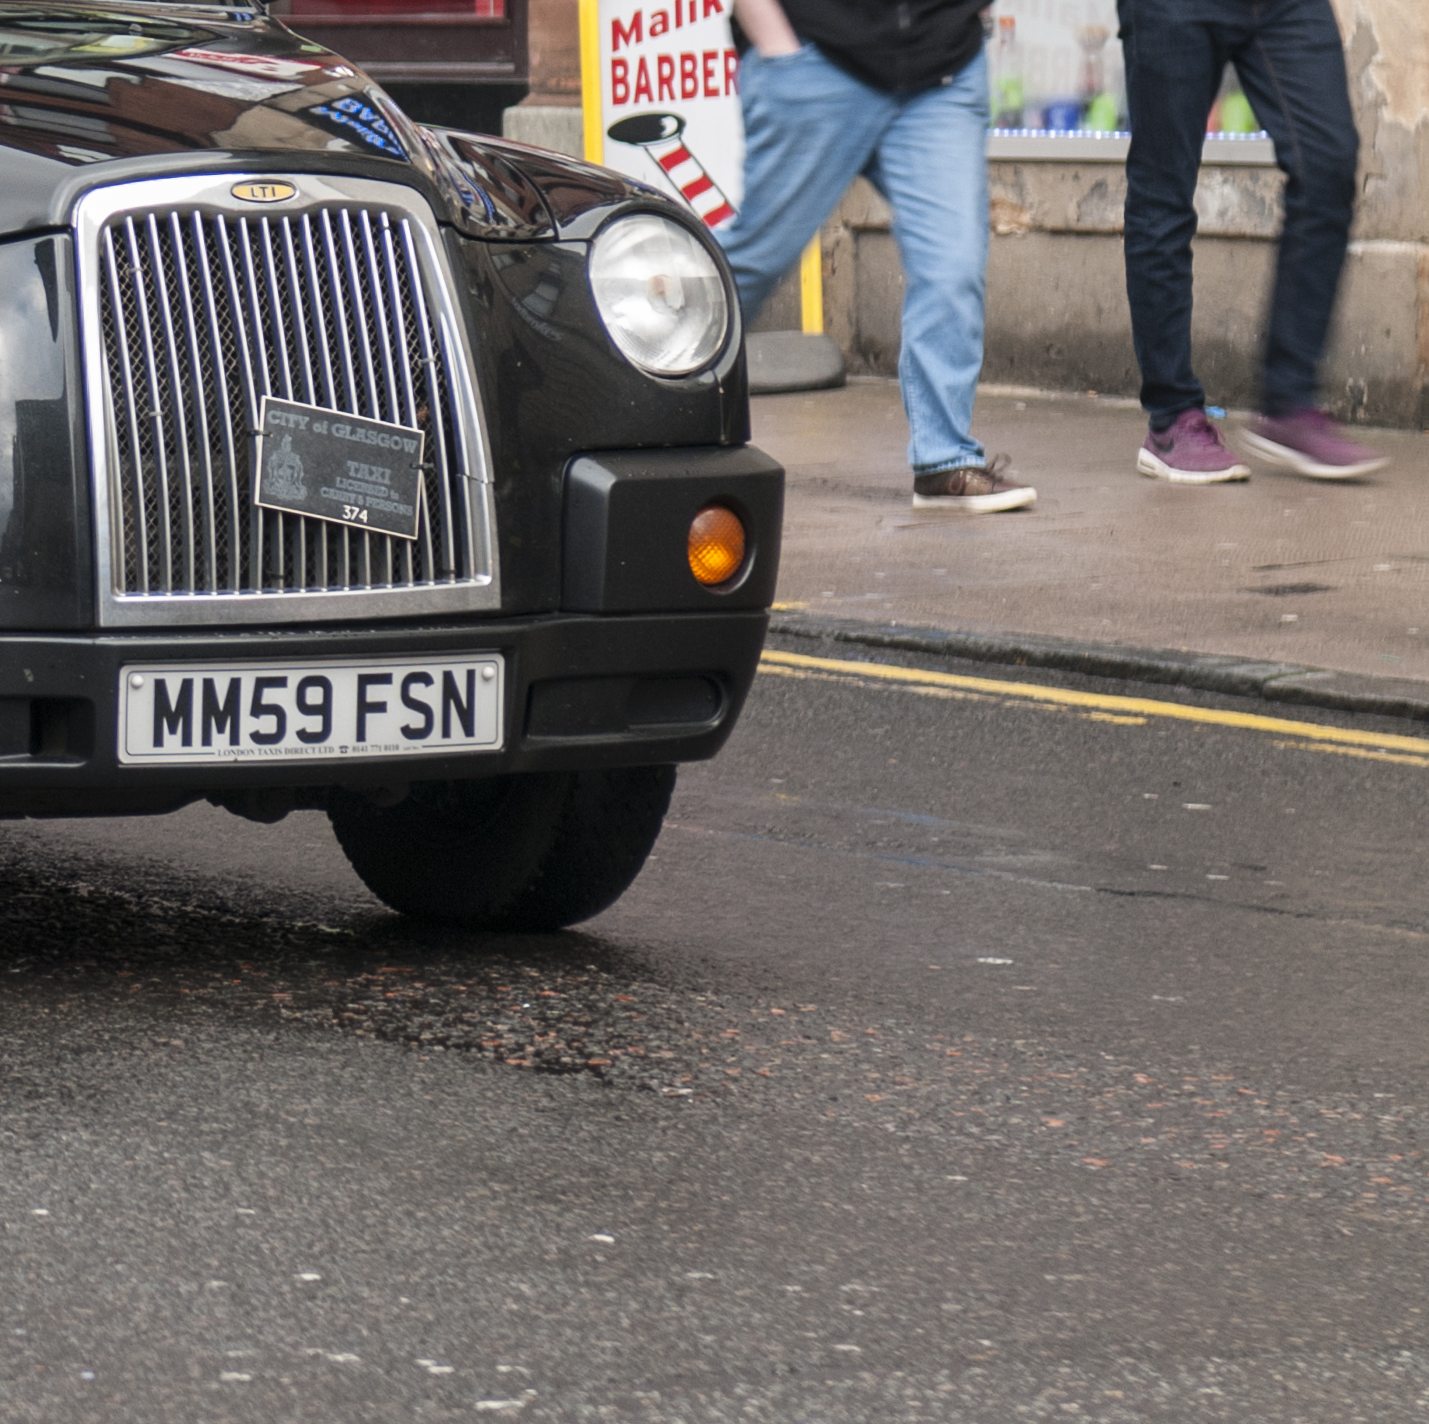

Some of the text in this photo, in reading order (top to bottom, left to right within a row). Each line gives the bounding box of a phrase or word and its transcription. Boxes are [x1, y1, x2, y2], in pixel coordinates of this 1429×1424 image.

[611, 49, 740, 106] BARBER
[250, 186, 276, 198] LTI
[267, 410, 419, 454] CITY of GLASGOW
[346, 460, 392, 484] TAXI
[320, 486, 352, 504] CARRY
[336, 477, 389, 497] LICENSED
[342, 504, 369, 523] 374
[153, 669, 476, 747] MM59 FSN
[218, 748, 256, 757] LONDON
[257, 748, 283, 756] TAXIS
[284, 747, 315, 755] DIRECT
[318, 746, 335, 754] LTD
[352, 745, 368, 753] 0141
[370, 745, 382, 753] 771
